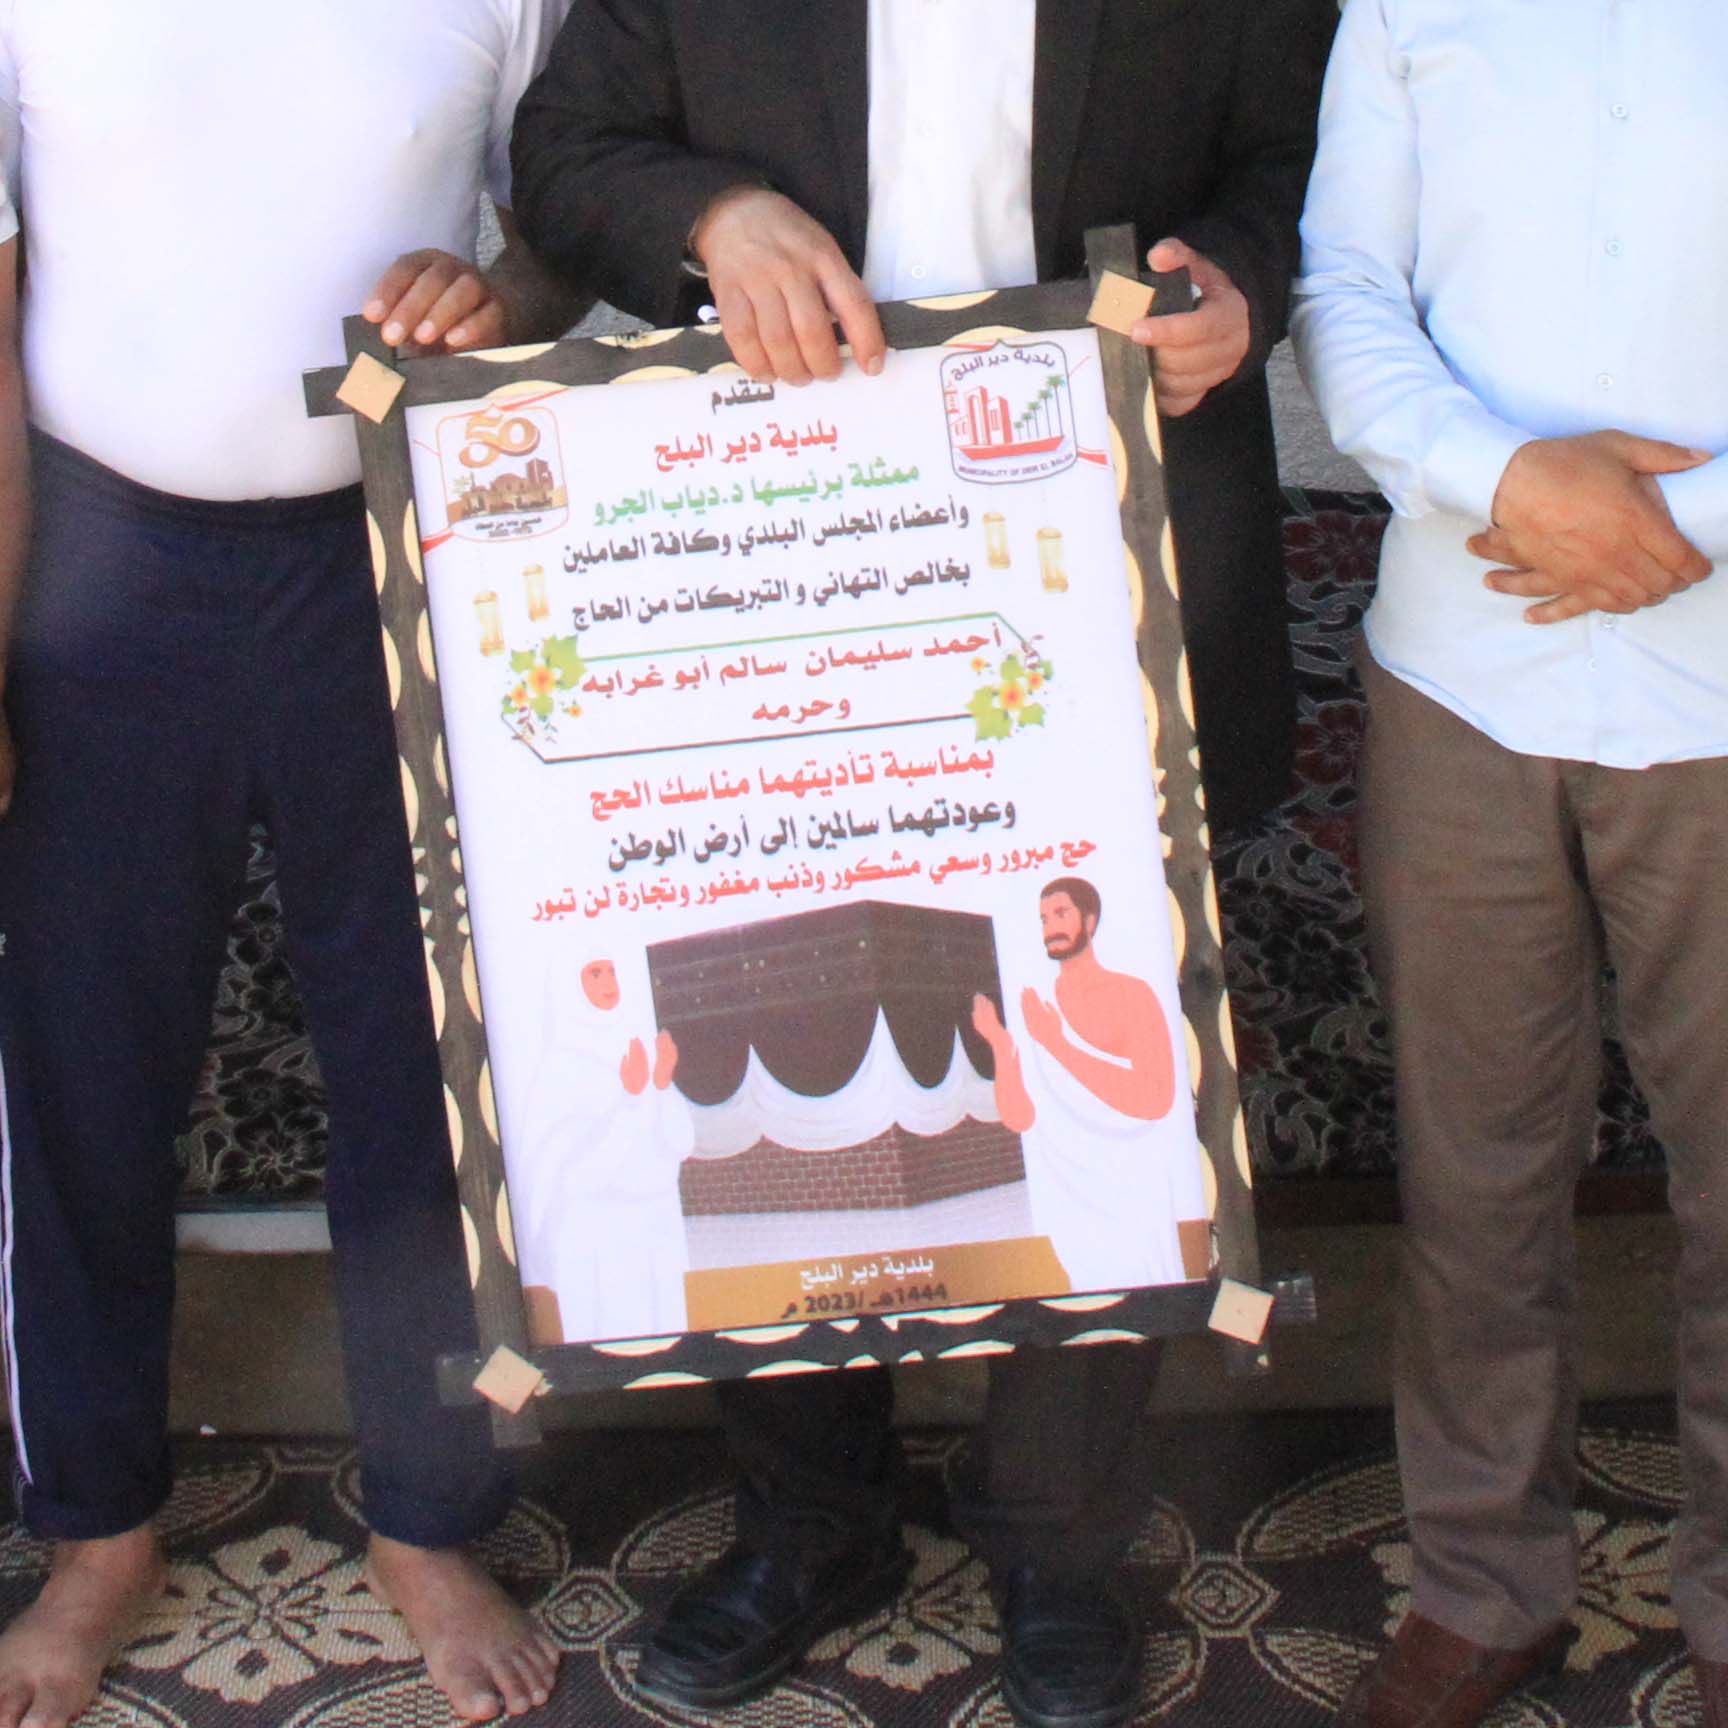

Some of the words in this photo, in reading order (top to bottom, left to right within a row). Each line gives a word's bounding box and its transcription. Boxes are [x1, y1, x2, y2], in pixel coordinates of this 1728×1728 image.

[459, 414, 541, 468] 50
[654, 433, 713, 471] البلح
[720, 431, 761, 463] دير
[766, 419, 838, 457] بلدية
[752, 470, 843, 506] برئيسها
[849, 456, 919, 487] ممثلة
[593, 490, 653, 525] الجرو
[890, 495, 970, 533] وأعضاء
[654, 529, 731, 556] وكافة
[739, 518, 805, 556] البلدي
[813, 509, 882, 546] المجلس
[563, 538, 646, 573] العاملين
[813, 567, 888, 606] التهاني
[895, 558, 970, 595] بخالص
[572, 596, 631, 631] الحاج
[638, 597, 668, 623] من
[923, 622, 1002, 658] أحمد
[672, 656, 710, 691] أبو
[720, 655, 787, 687] سالم
[805, 640, 912, 677] سليمان
[752, 697, 851, 724] وحرمه
[759, 750, 874, 798] تأديتهما
[881, 744, 994, 787] بمناسبة
[590, 778, 651, 821] الحج
[659, 769, 750, 804] مناسك
[807, 809, 879, 849] سالمين
[889, 798, 1016, 837] وعودتهما
[609, 827, 686, 872] الوطن
[694, 814, 749, 863] أرض
[1060, 838, 1097, 868] حج
[831, 849, 921, 891] مشكور
[929, 852, 991, 885] وسعي
[998, 844, 1054, 873] مبرور
[616, 877, 690, 911] وتجارة
[695, 871, 760, 905] مغفور
[767, 861, 825, 898] وذنب
[532, 887, 576, 922] تبور
[584, 885, 610, 918] لن
[800, 1262, 844, 1290] البلح
[850, 1263, 879, 1286] دير
[883, 1255, 934, 1281] بلدية
